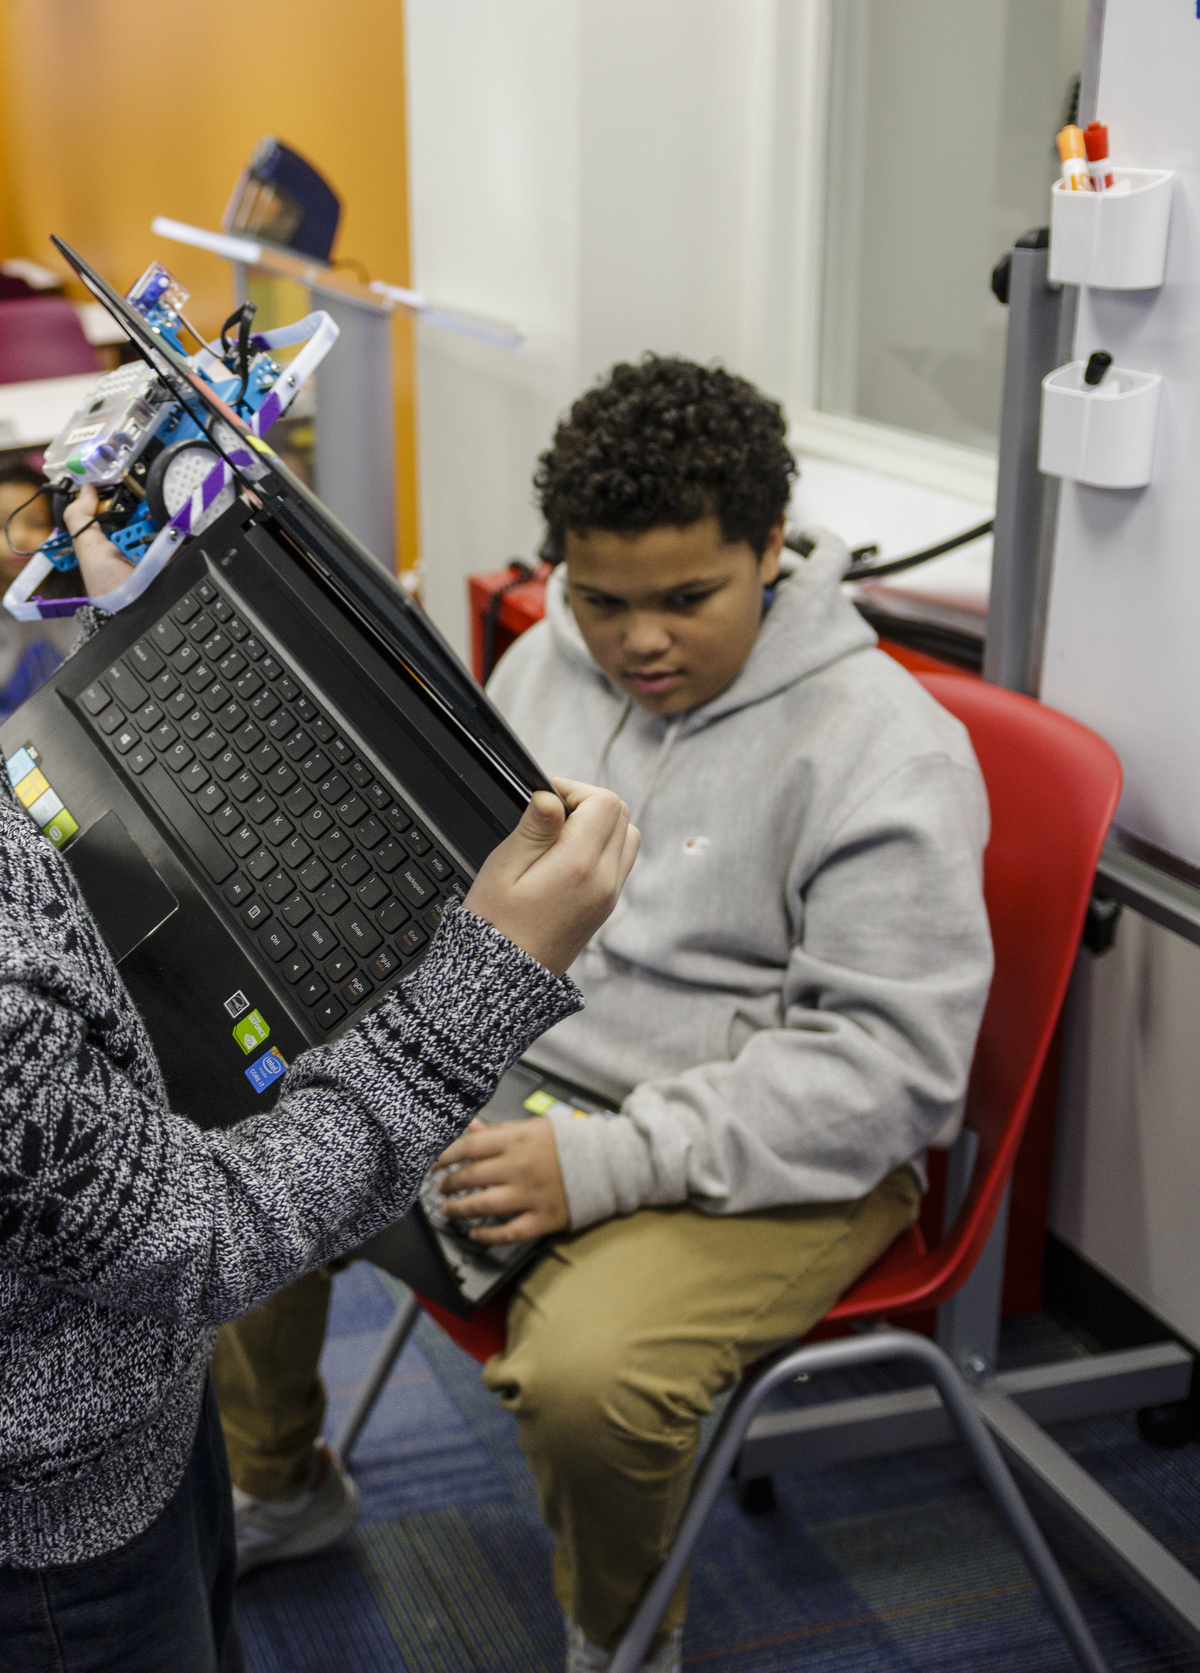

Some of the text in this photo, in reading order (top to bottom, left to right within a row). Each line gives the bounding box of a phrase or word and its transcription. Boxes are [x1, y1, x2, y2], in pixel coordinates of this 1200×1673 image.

[182, 648, 190, 657] Q
[197, 665, 208, 676] W
[162, 674, 170, 682] A
[212, 684, 220, 694] E
[176, 692, 184, 702] S
[144, 705, 154, 714] Z
[227, 704, 236, 714] R
[191, 712, 200, 721] D
[160, 724, 169, 734] X
[244, 724, 253, 732] T
[207, 731, 216, 739] F
[175, 745, 184, 754] C
[262, 745, 270, 753] Y
[224, 752, 232, 762] G
[192, 765, 200, 773] V
[278, 766, 287, 775] U
[240, 772, 249, 782] H
[206, 785, 216, 794] B
[223, 806, 232, 816] N
[274, 816, 283, 826] K
[240, 828, 250, 839] M
[291, 838, 298, 847] L
[404, 871, 425, 896] Backspace
[233, 884, 241, 894] Alt
[351, 922, 364, 938] Enter
[270, 934, 280, 946] Ctrl
[312, 930, 324, 944] Shift
[408, 930, 419, 942] End
[380, 953, 392, 968] PgUp
[352, 978, 364, 993] PgDn
[248, 1014, 268, 1038] GEFORCE
[266, 1057, 278, 1072] intel
[250, 1068, 260, 1082] CORE
